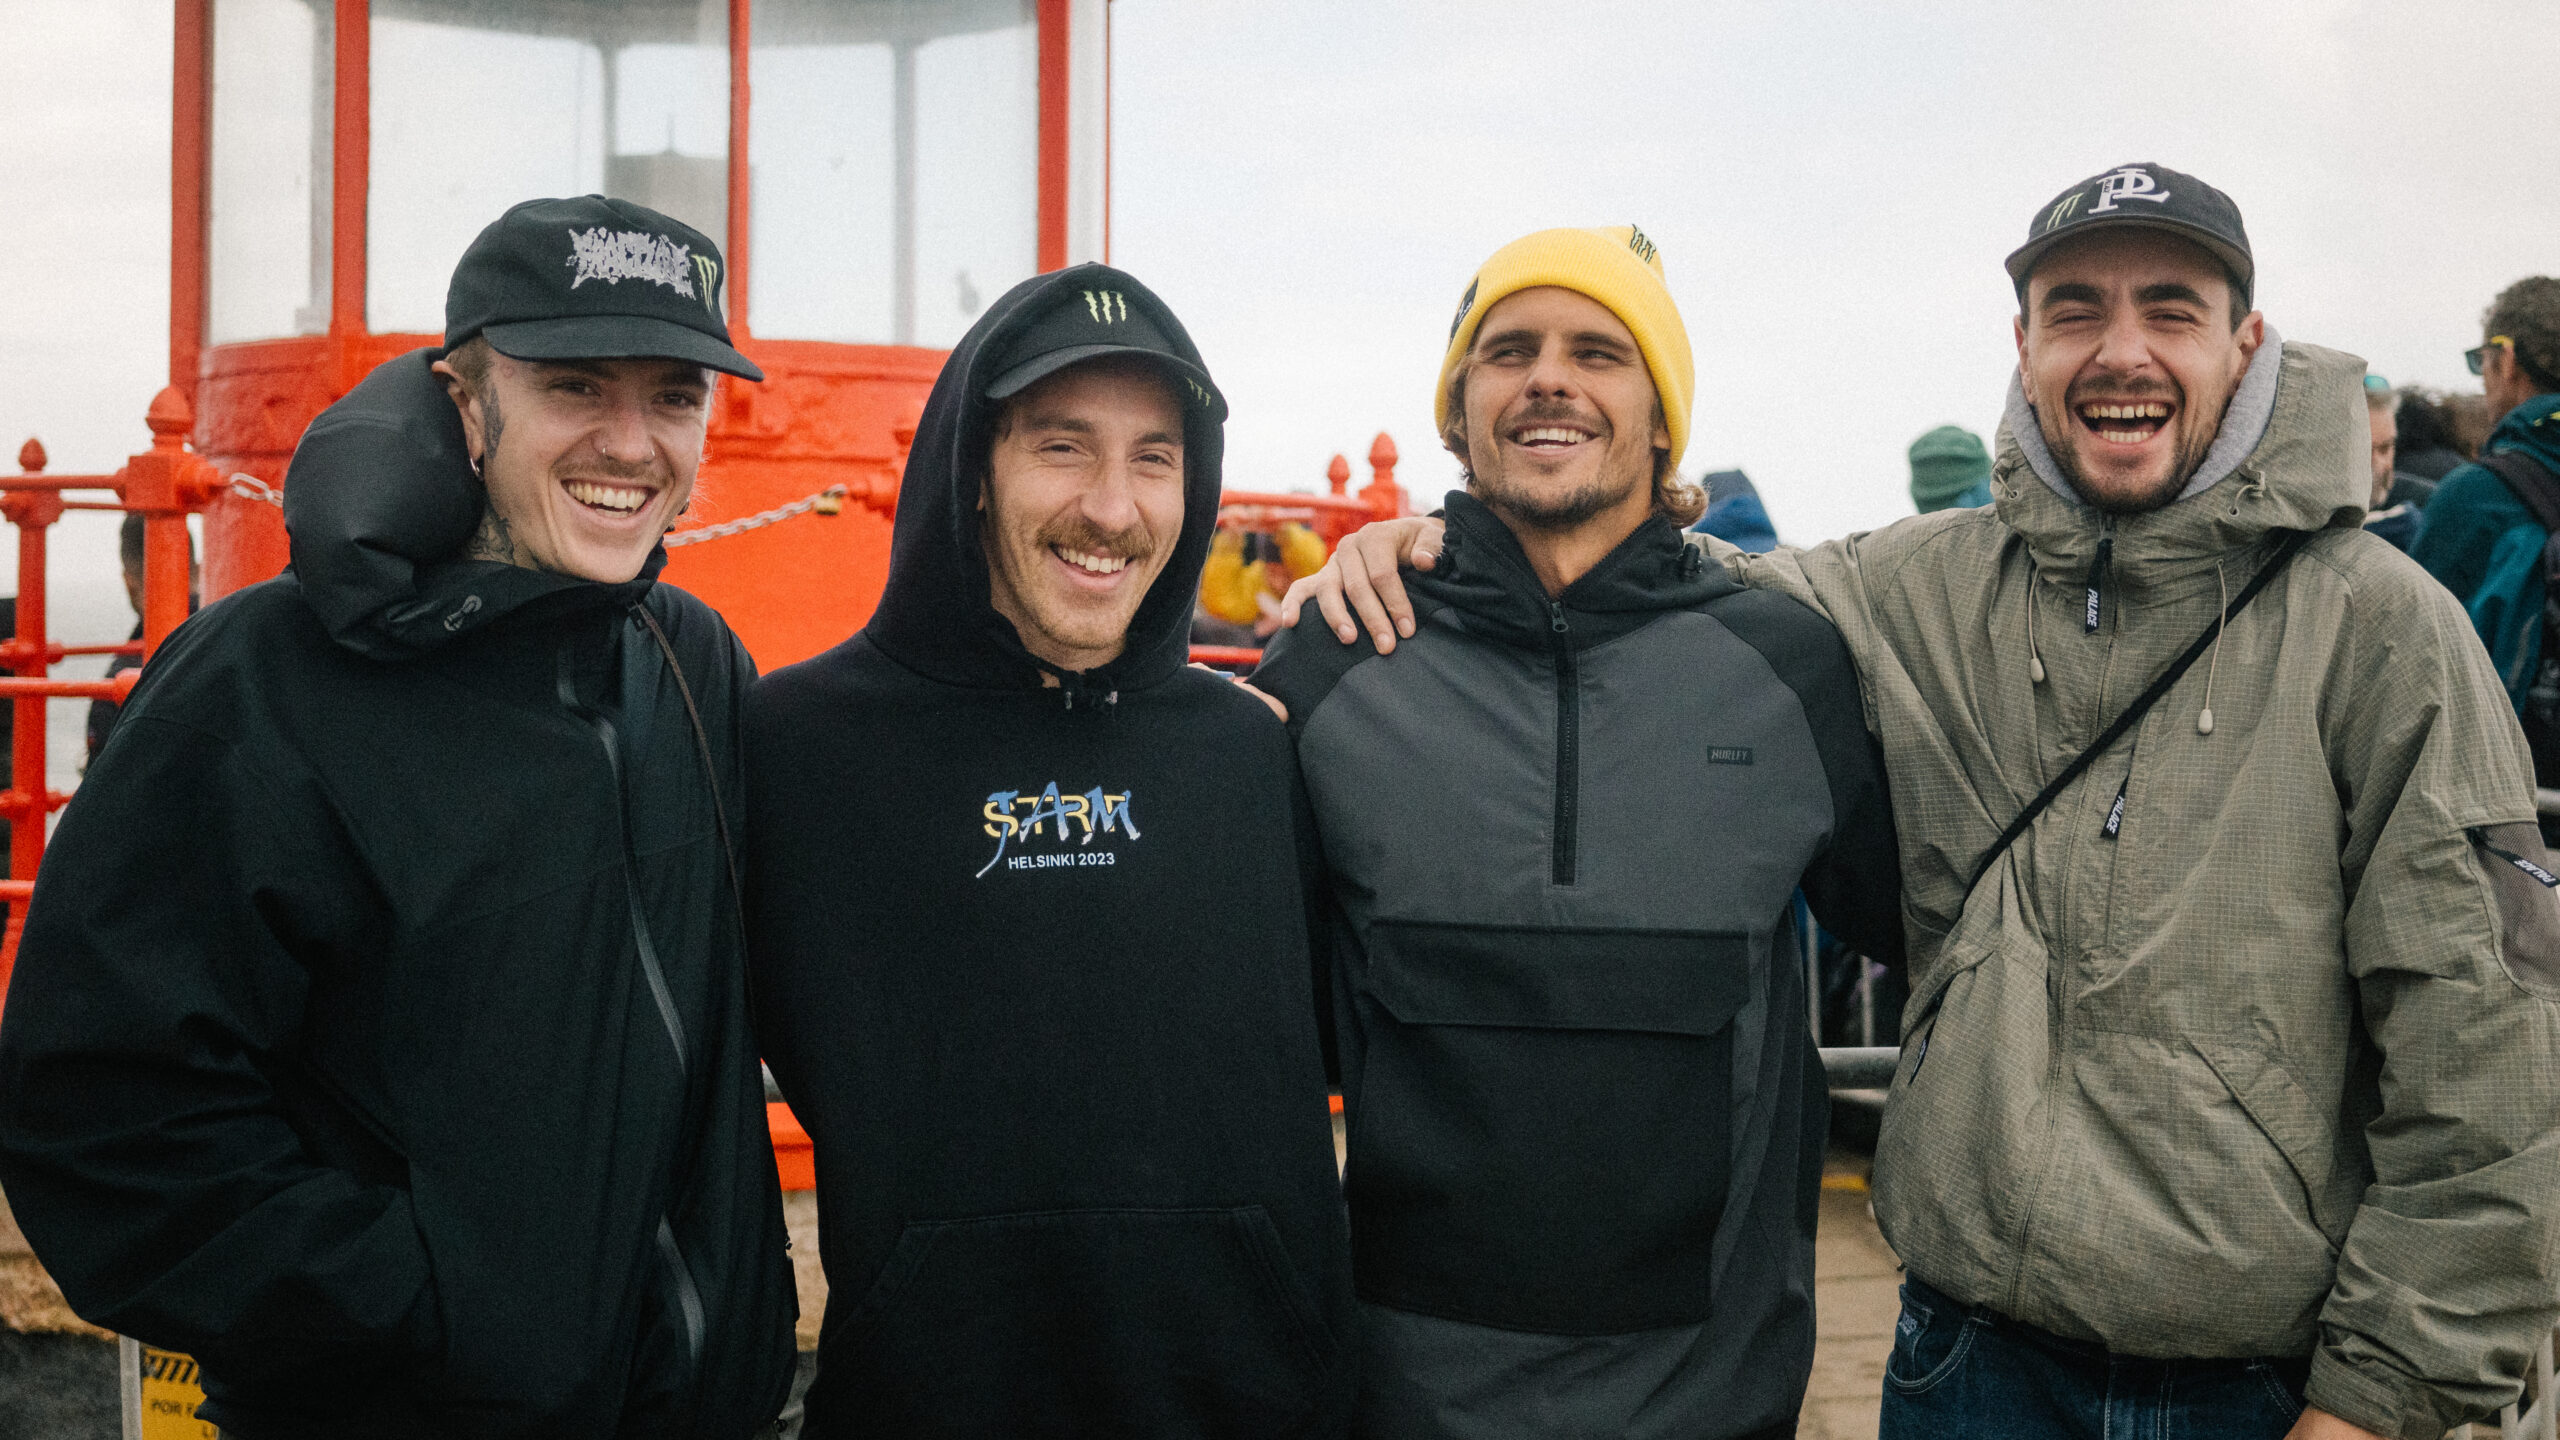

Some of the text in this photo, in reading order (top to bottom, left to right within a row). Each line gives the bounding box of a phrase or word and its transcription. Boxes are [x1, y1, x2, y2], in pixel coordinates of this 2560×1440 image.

[2087, 587, 2099, 628] PALACE
[2106, 795, 2125, 834] PALACE
[1008, 853, 1115, 870] HELSINKI 2023
[2513, 859, 2556, 883] PALACE
